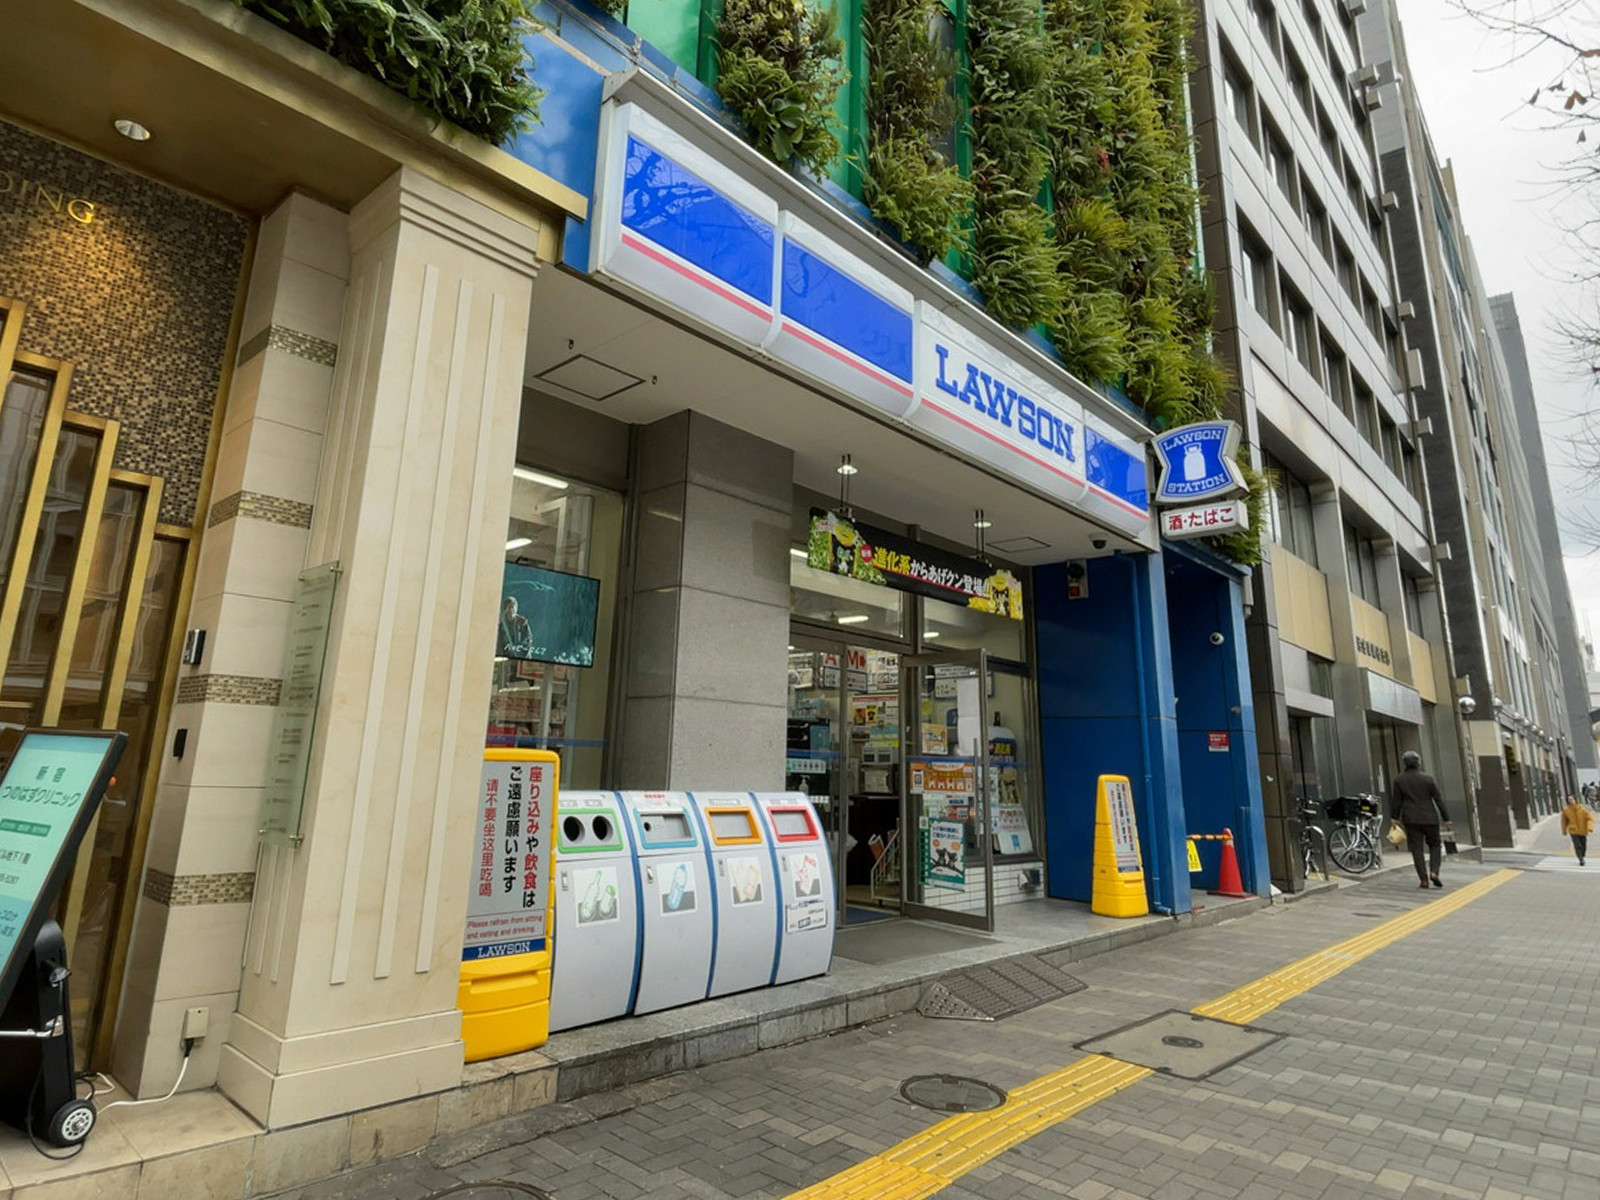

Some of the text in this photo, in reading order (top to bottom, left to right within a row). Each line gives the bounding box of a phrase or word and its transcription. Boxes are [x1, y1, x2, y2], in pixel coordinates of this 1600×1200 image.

[936, 344, 1075, 462] LAWSON
[1163, 430, 1222, 451] LAWSON
[1168, 473, 1226, 493] STATION
[2, 785, 82, 807] つのはずクリニック
[479, 779, 499, 897] 请不要坐这里吃喝
[503, 766, 522, 893] ご遠慮願います
[522, 766, 543, 908] 座り込みや飲食は
[467, 915, 542, 929] Please refrain from sitting
[480, 930, 499, 938] eating
[477, 941, 531, 959] LAWSON
